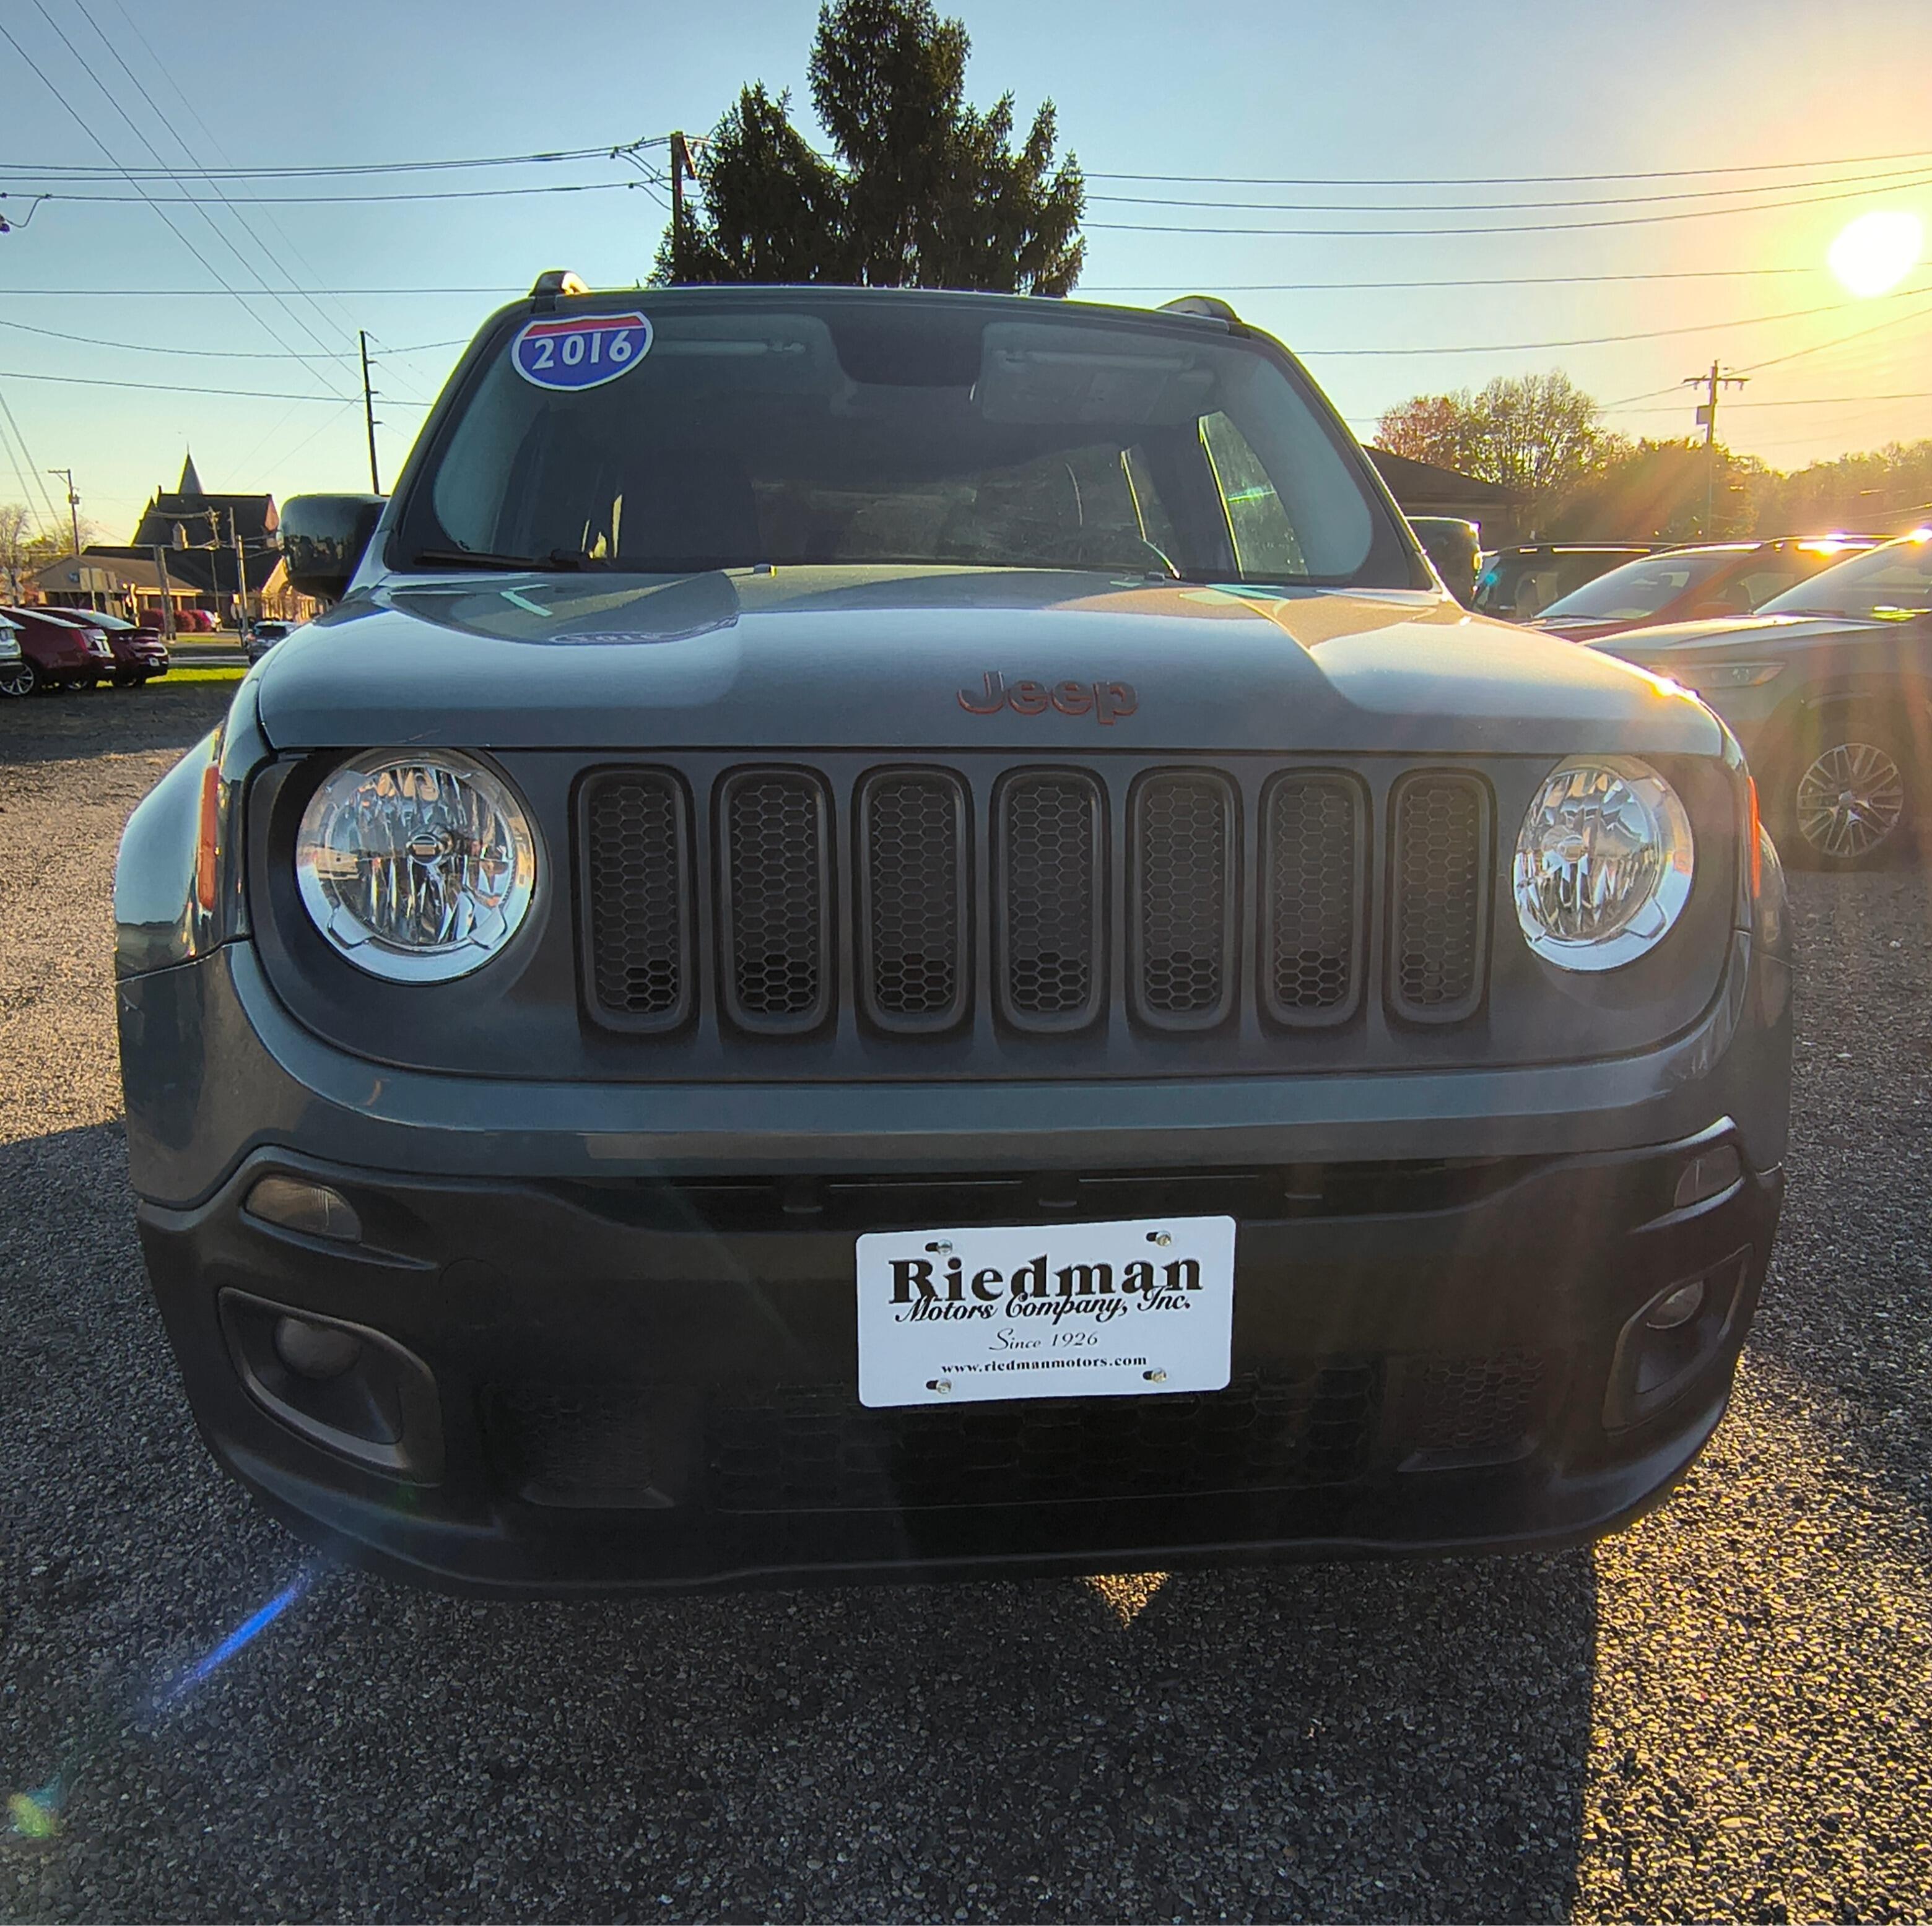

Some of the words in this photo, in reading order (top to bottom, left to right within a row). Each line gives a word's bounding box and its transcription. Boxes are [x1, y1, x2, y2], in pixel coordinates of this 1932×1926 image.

[531, 330, 632, 370] 2016
[957, 670, 1139, 726] Jeep
[888, 1254, 1203, 1304] Riedman
[895, 1295, 998, 1322] Motors
[1004, 1292, 1128, 1325] Company,
[1136, 1285, 1191, 1311] Inc.
[988, 1328, 1042, 1351] Since
[1051, 1330, 1099, 1347] 1926
[941, 1356, 1147, 1374] www.riedmanmotors.com
